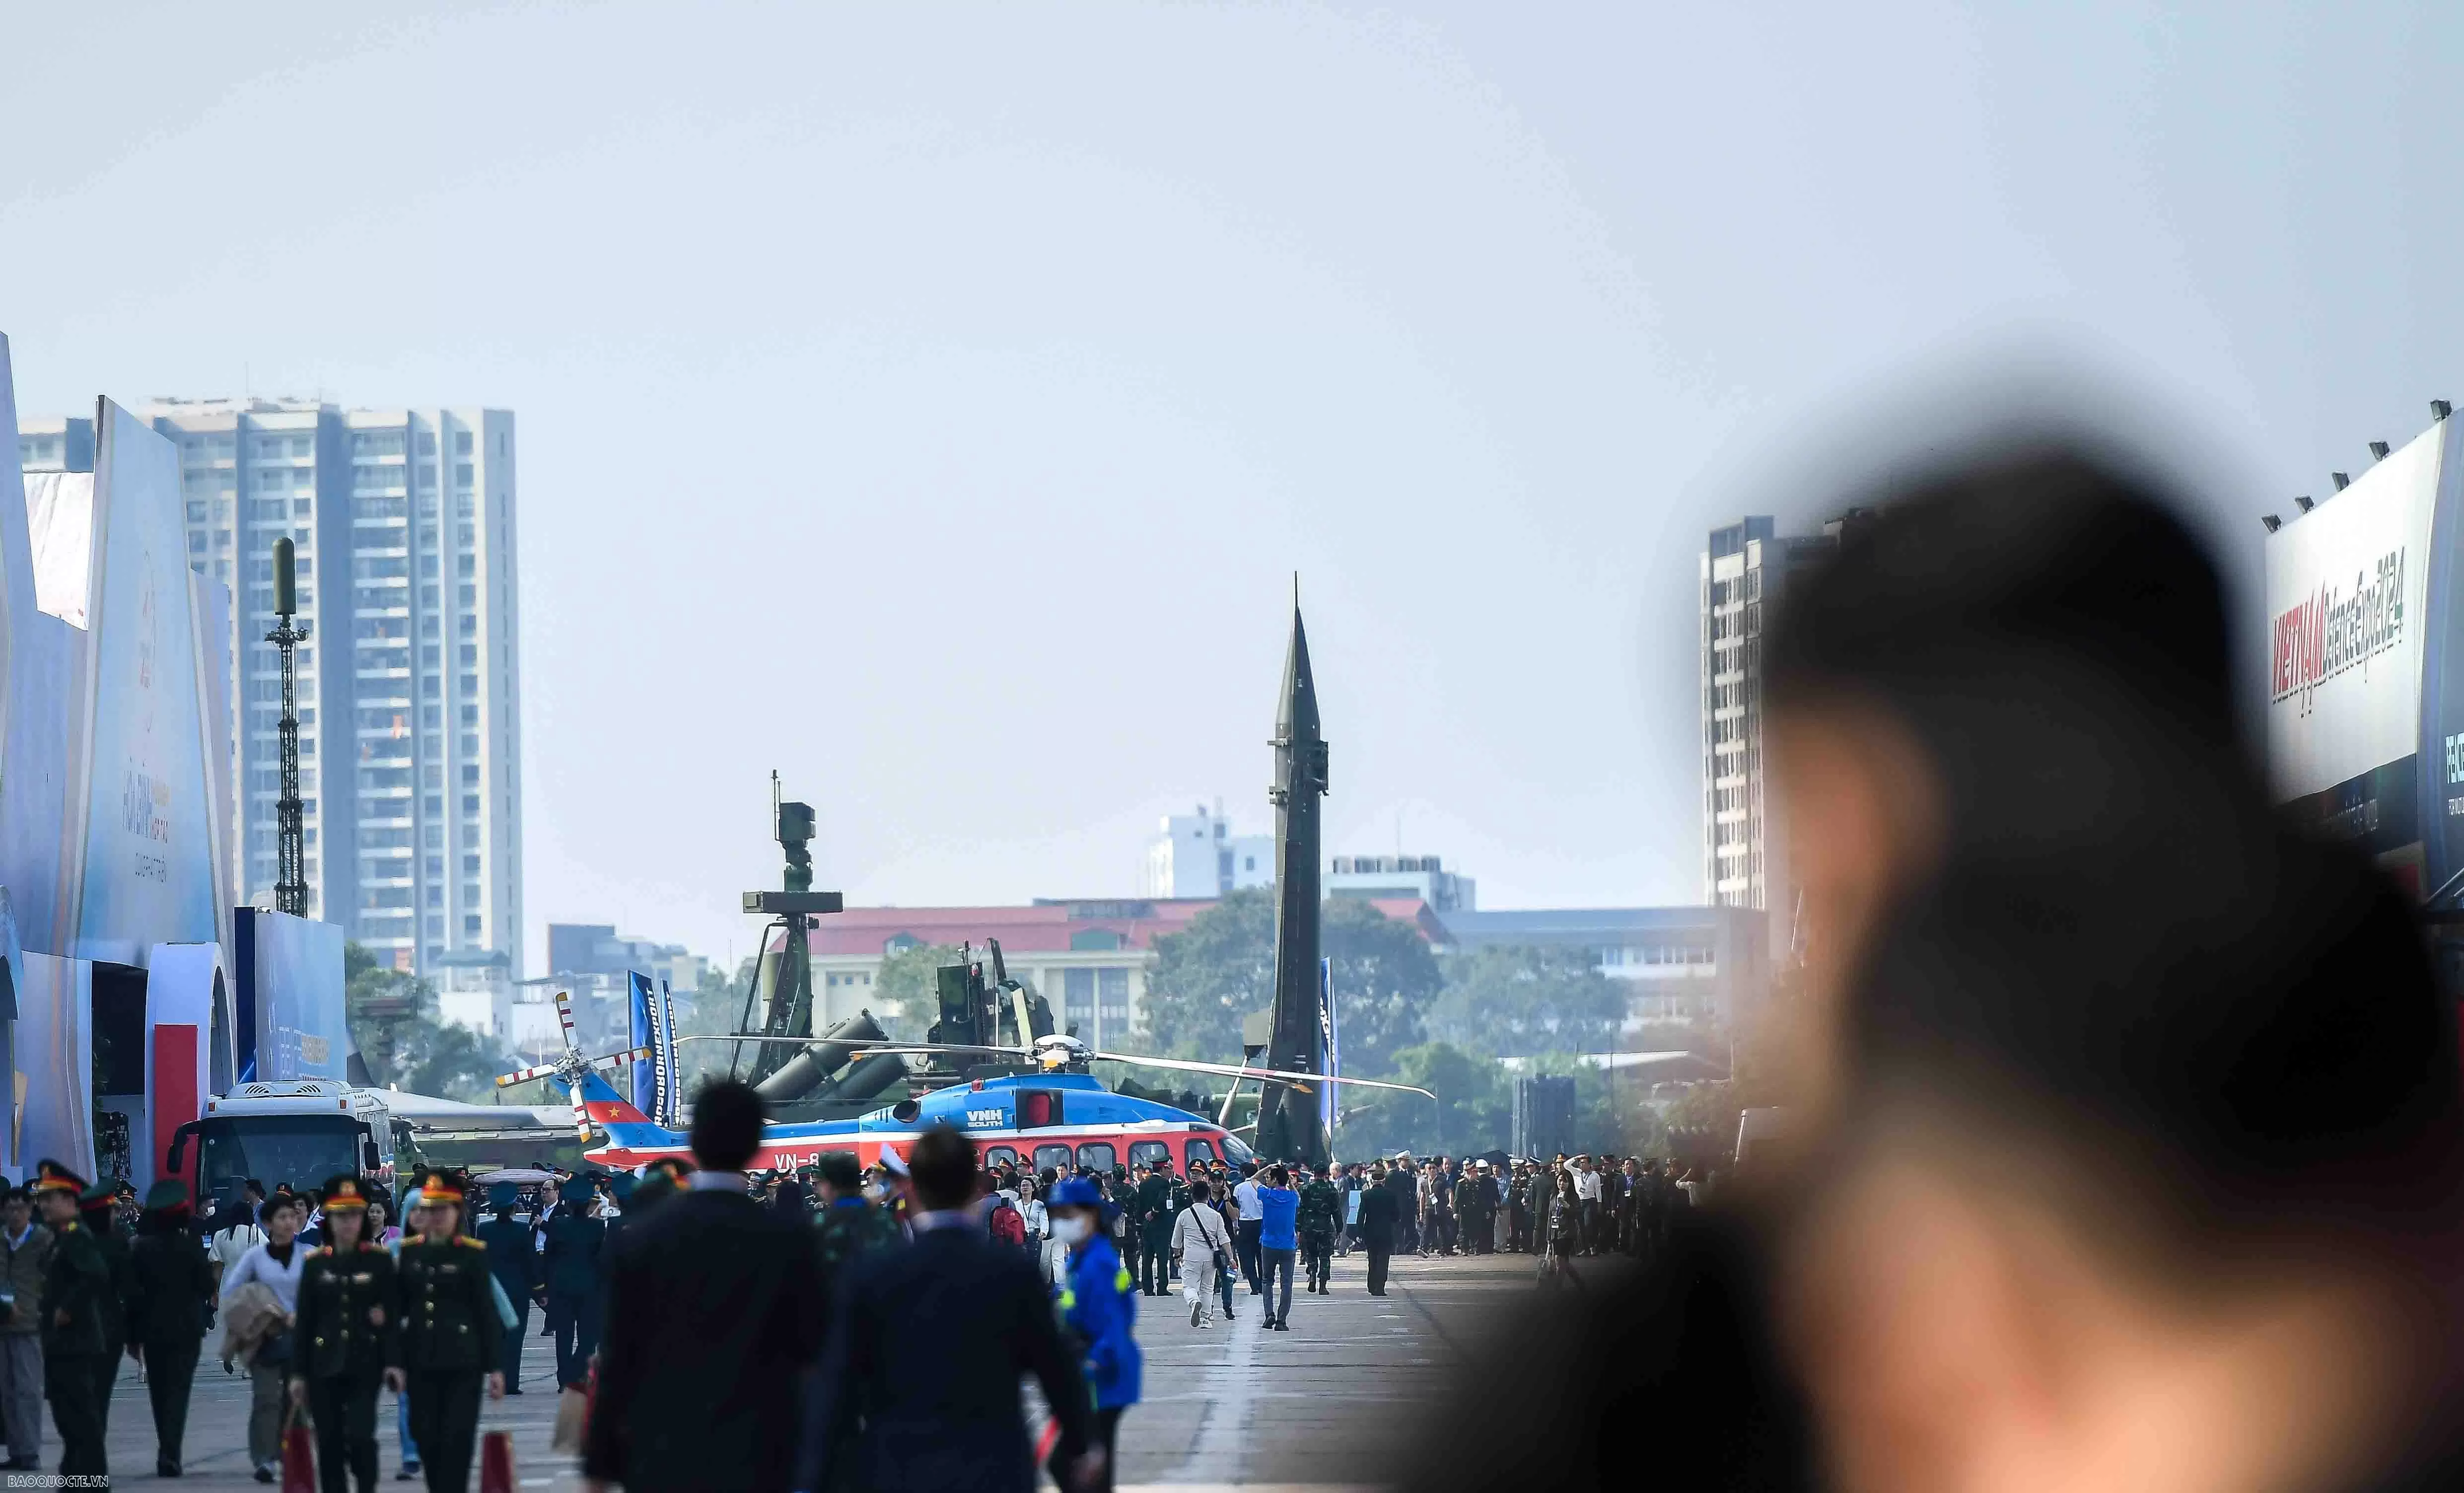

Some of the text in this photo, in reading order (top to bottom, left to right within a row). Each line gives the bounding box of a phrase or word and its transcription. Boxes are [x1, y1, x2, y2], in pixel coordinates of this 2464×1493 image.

[2272, 546, 2404, 711] VIETNAM Defence Expo 2024
[967, 1109, 1002, 1121] VNH
[774, 1152, 819, 1169] VN-8
